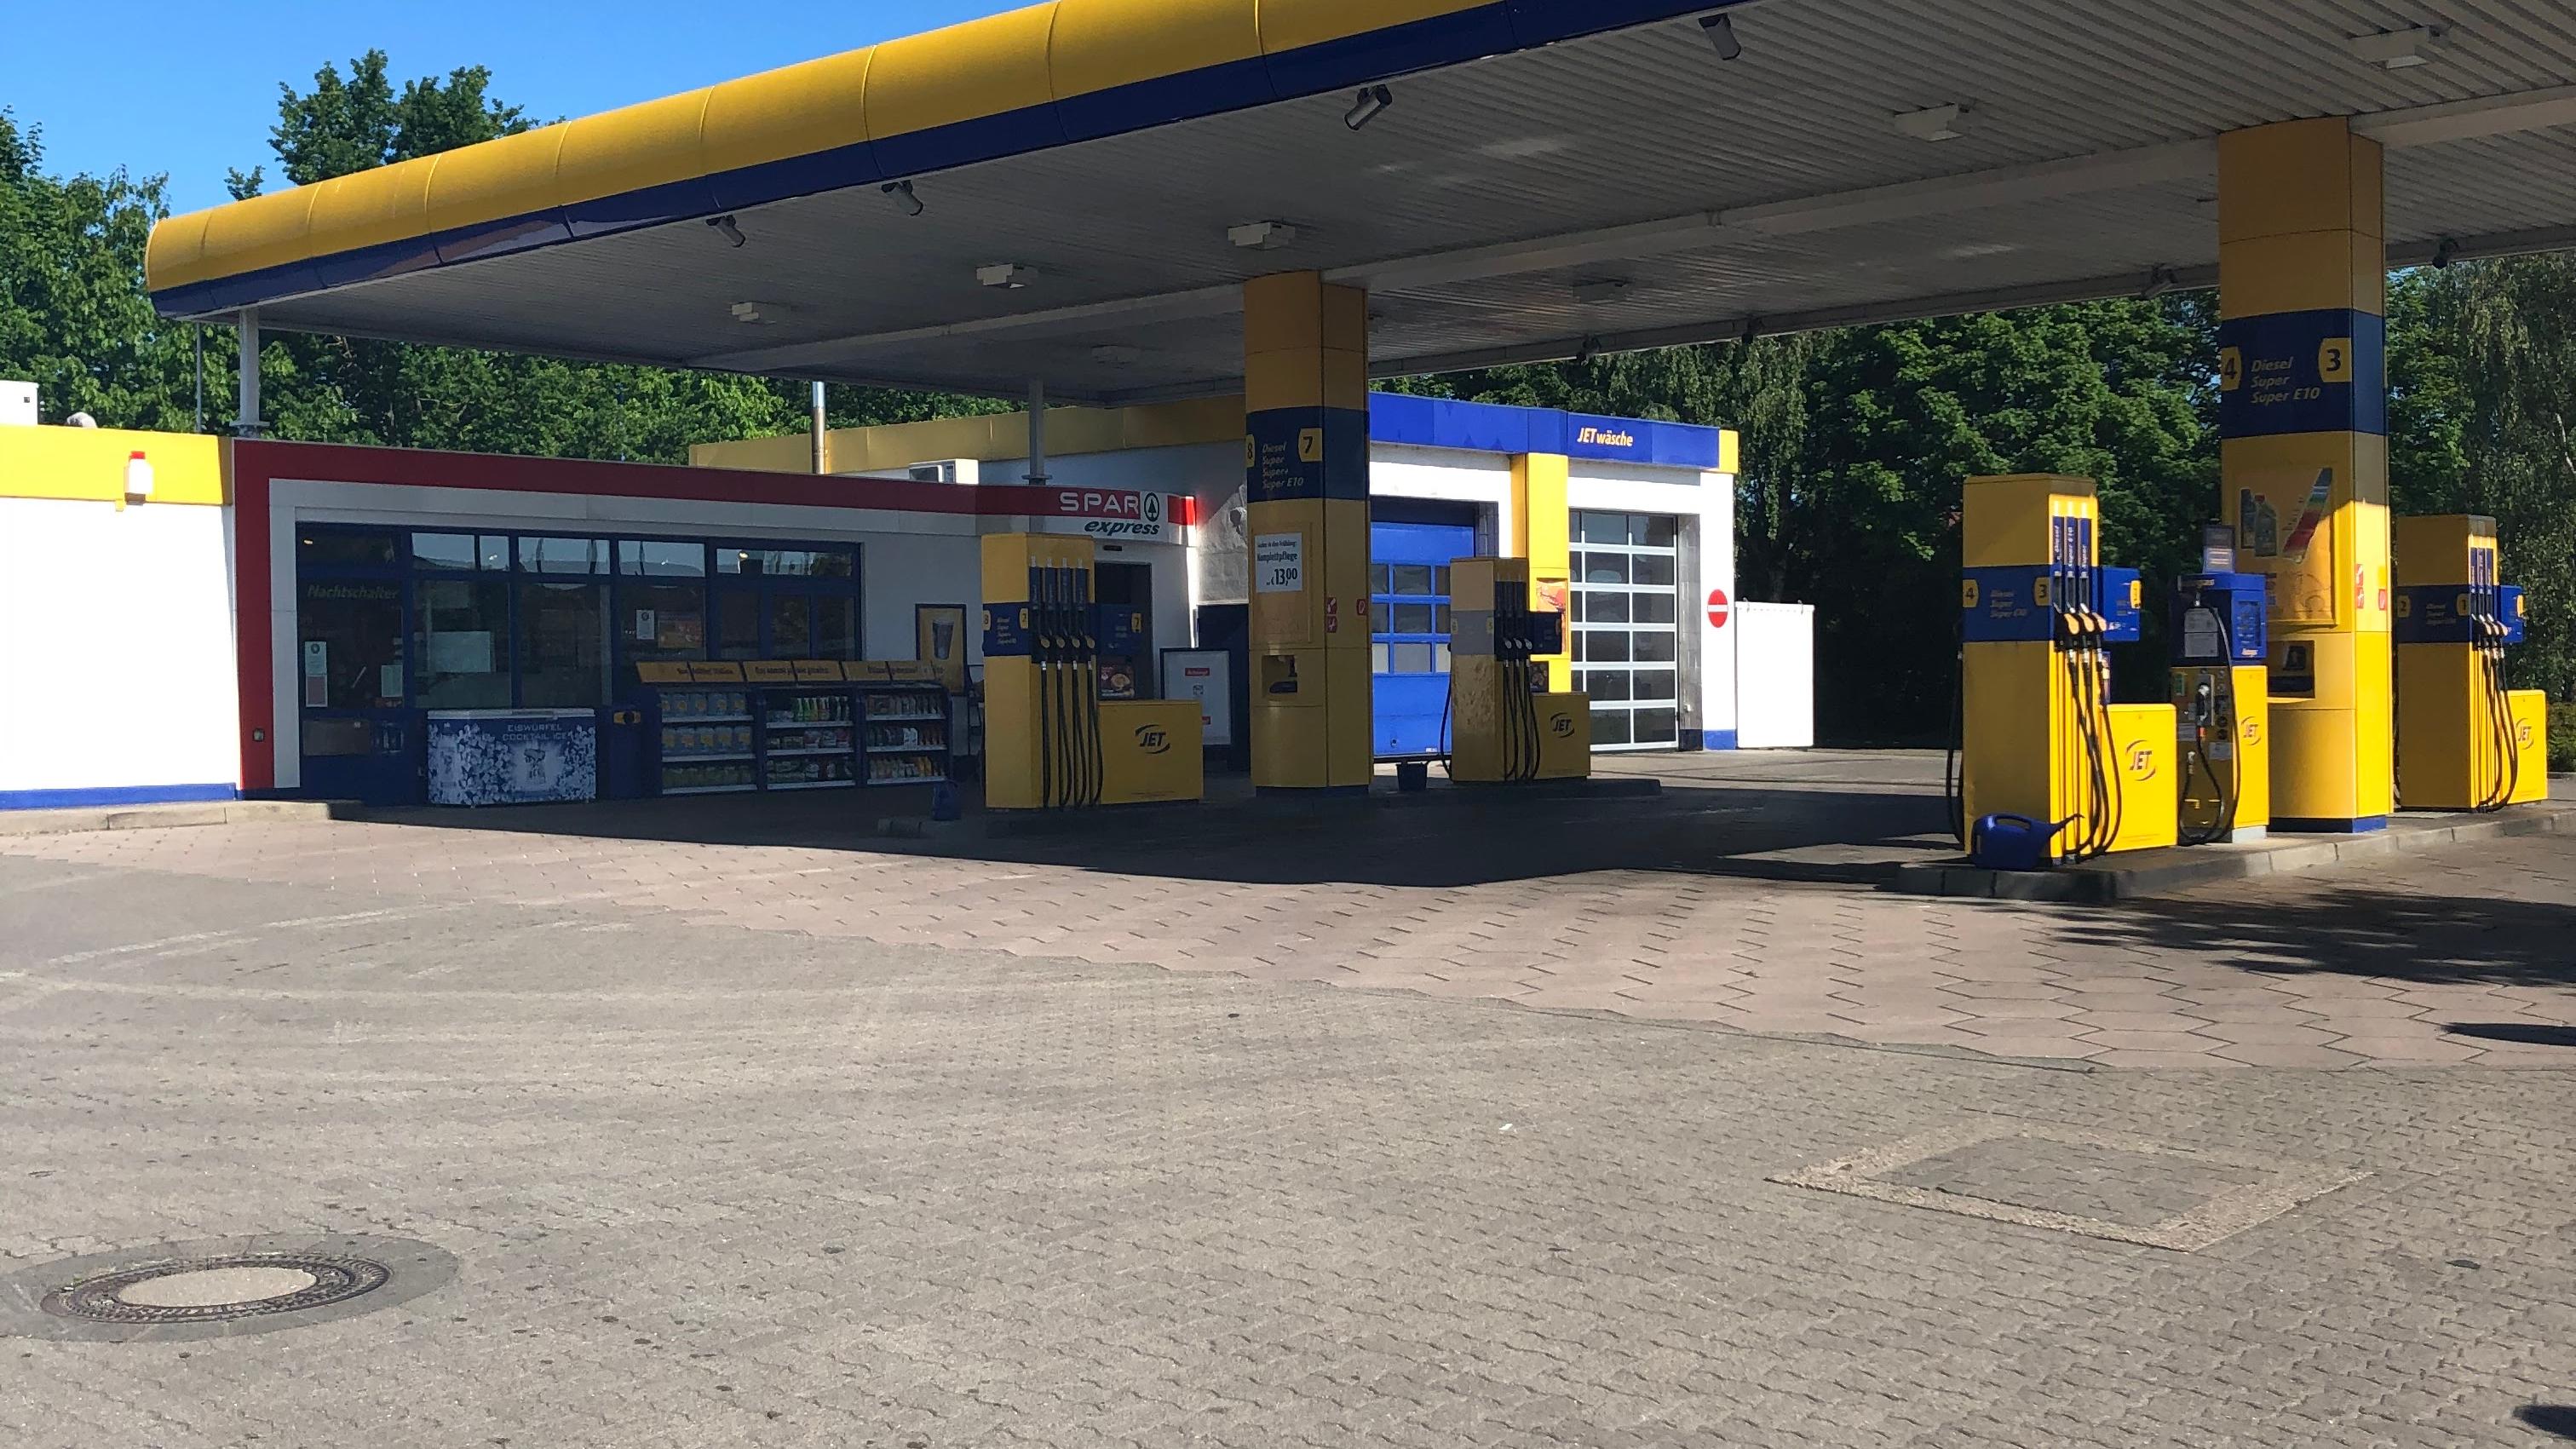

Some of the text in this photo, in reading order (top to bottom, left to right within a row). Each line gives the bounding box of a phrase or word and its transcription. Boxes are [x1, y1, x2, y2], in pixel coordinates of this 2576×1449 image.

[2251, 356, 2294, 372] Diesel
[2326, 348, 2342, 372] 3
[2224, 357, 2238, 380] 4
[2251, 376, 2291, 390] Super
[2251, 387, 2322, 406] Super E10
[1247, 441, 1253, 460] 8
[1262, 442, 1288, 453] Diesel
[1302, 435, 1314, 454] 7
[1286, 476, 1304, 487] E10
[1059, 491, 1140, 515] SPAR
[1084, 520, 1160, 537] express
[1966, 586, 1974, 599] 4
[2038, 584, 2047, 598] 3
[1553, 718, 1573, 733] JET
[2244, 724, 2259, 738] JET
[503, 732, 549, 741] COCKTAIL
[1139, 733, 1166, 747] JET
[2517, 726, 2532, 742] JET
[2129, 750, 2153, 771] JET
